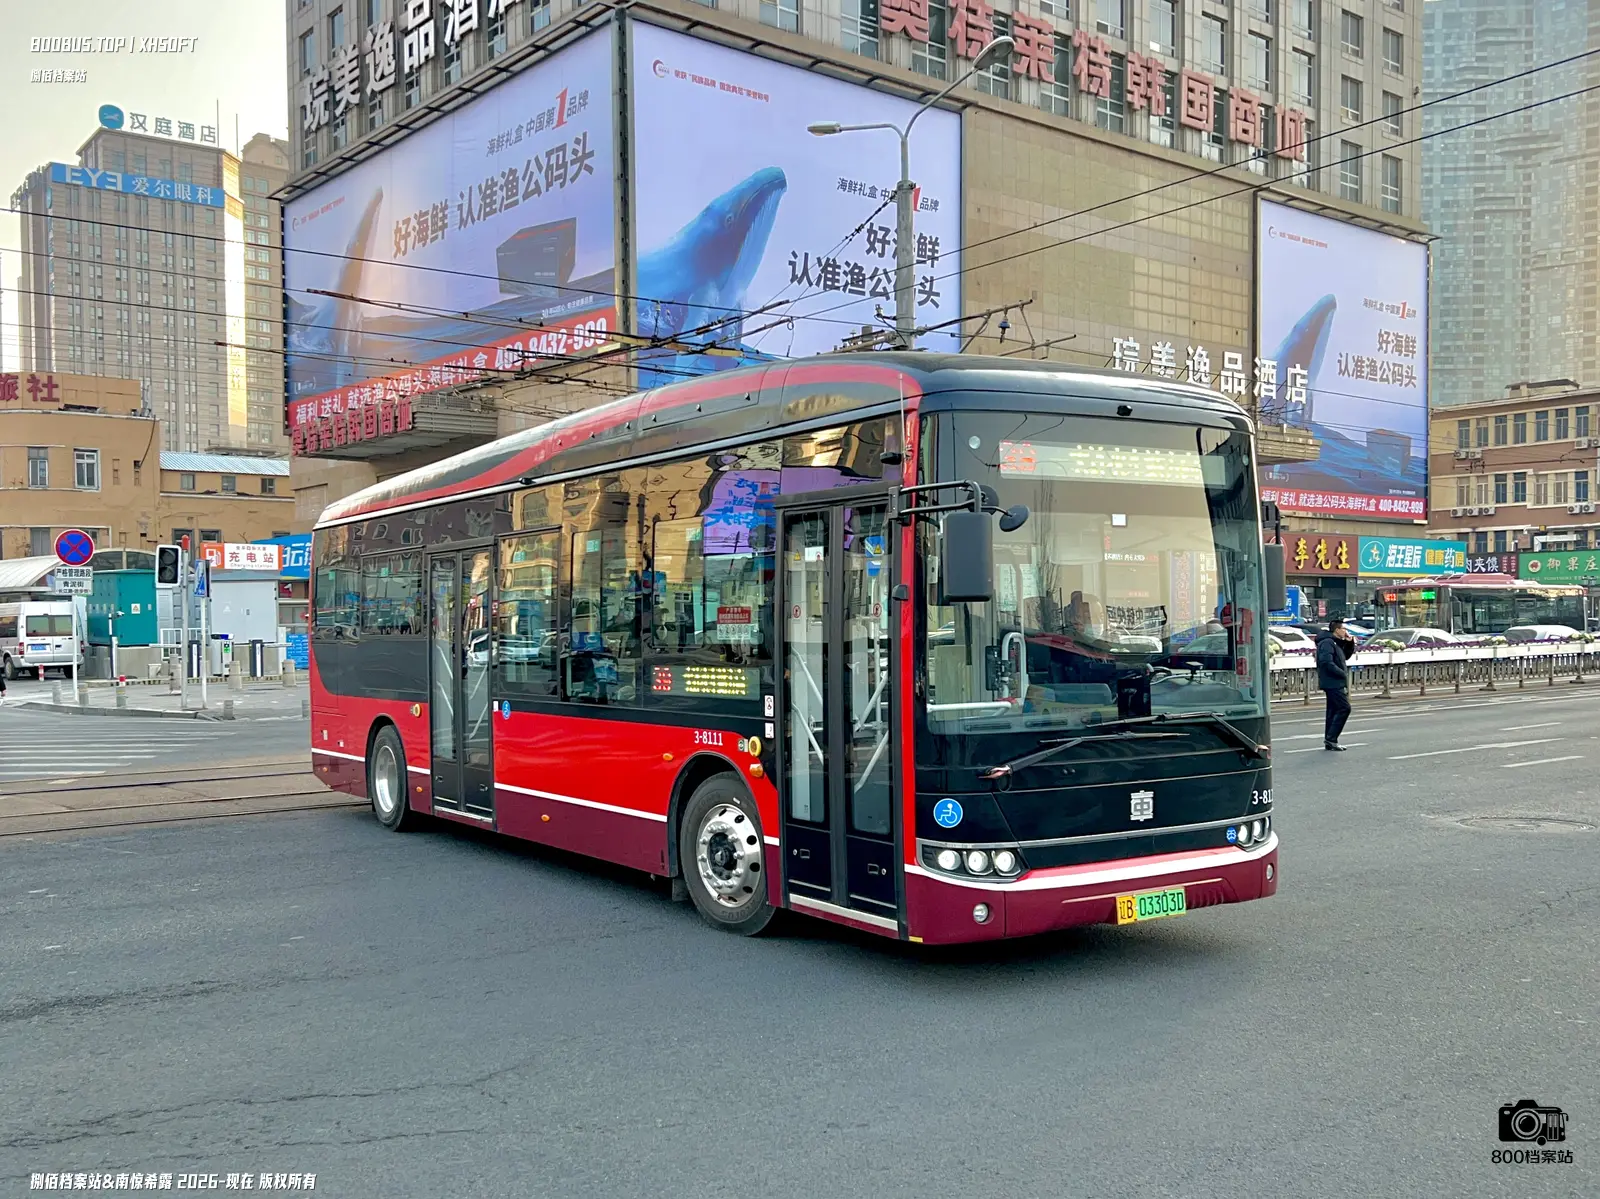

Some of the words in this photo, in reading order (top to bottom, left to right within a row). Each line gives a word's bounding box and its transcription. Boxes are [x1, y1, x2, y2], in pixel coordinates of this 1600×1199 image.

[129, 112, 217, 144] 汉庭酒店
[486, 133, 524, 157] 海鲜礼盒
[131, 176, 214, 205] 爱尔眼科
[392, 199, 449, 260] 好海鲜
[457, 132, 595, 232] 认准渔公码头
[837, 177, 879, 200] 海鲜礼盒
[788, 250, 941, 309] 认准渔公头
[1377, 328, 1417, 360] 好海鲜
[1337, 351, 1417, 389] 认准渔公码头
[0, 373, 60, 402] 旅社
[296, 400, 318, 424] 福利
[321, 391, 344, 417] 送礼
[1280, 492, 1296, 506] 送礼
[1298, 493, 1377, 512] 就选渔公码头海鲜礼盒
[1378, 500, 1425, 514] 400-8432-999
[229, 551, 275, 564] 充电站
[1295, 537, 1351, 570] 李先生
[1386, 544, 1423, 569] 海王星辰
[694, 730, 723, 746] 3-8111
[1139, 892, 1185, 916] 03303D
